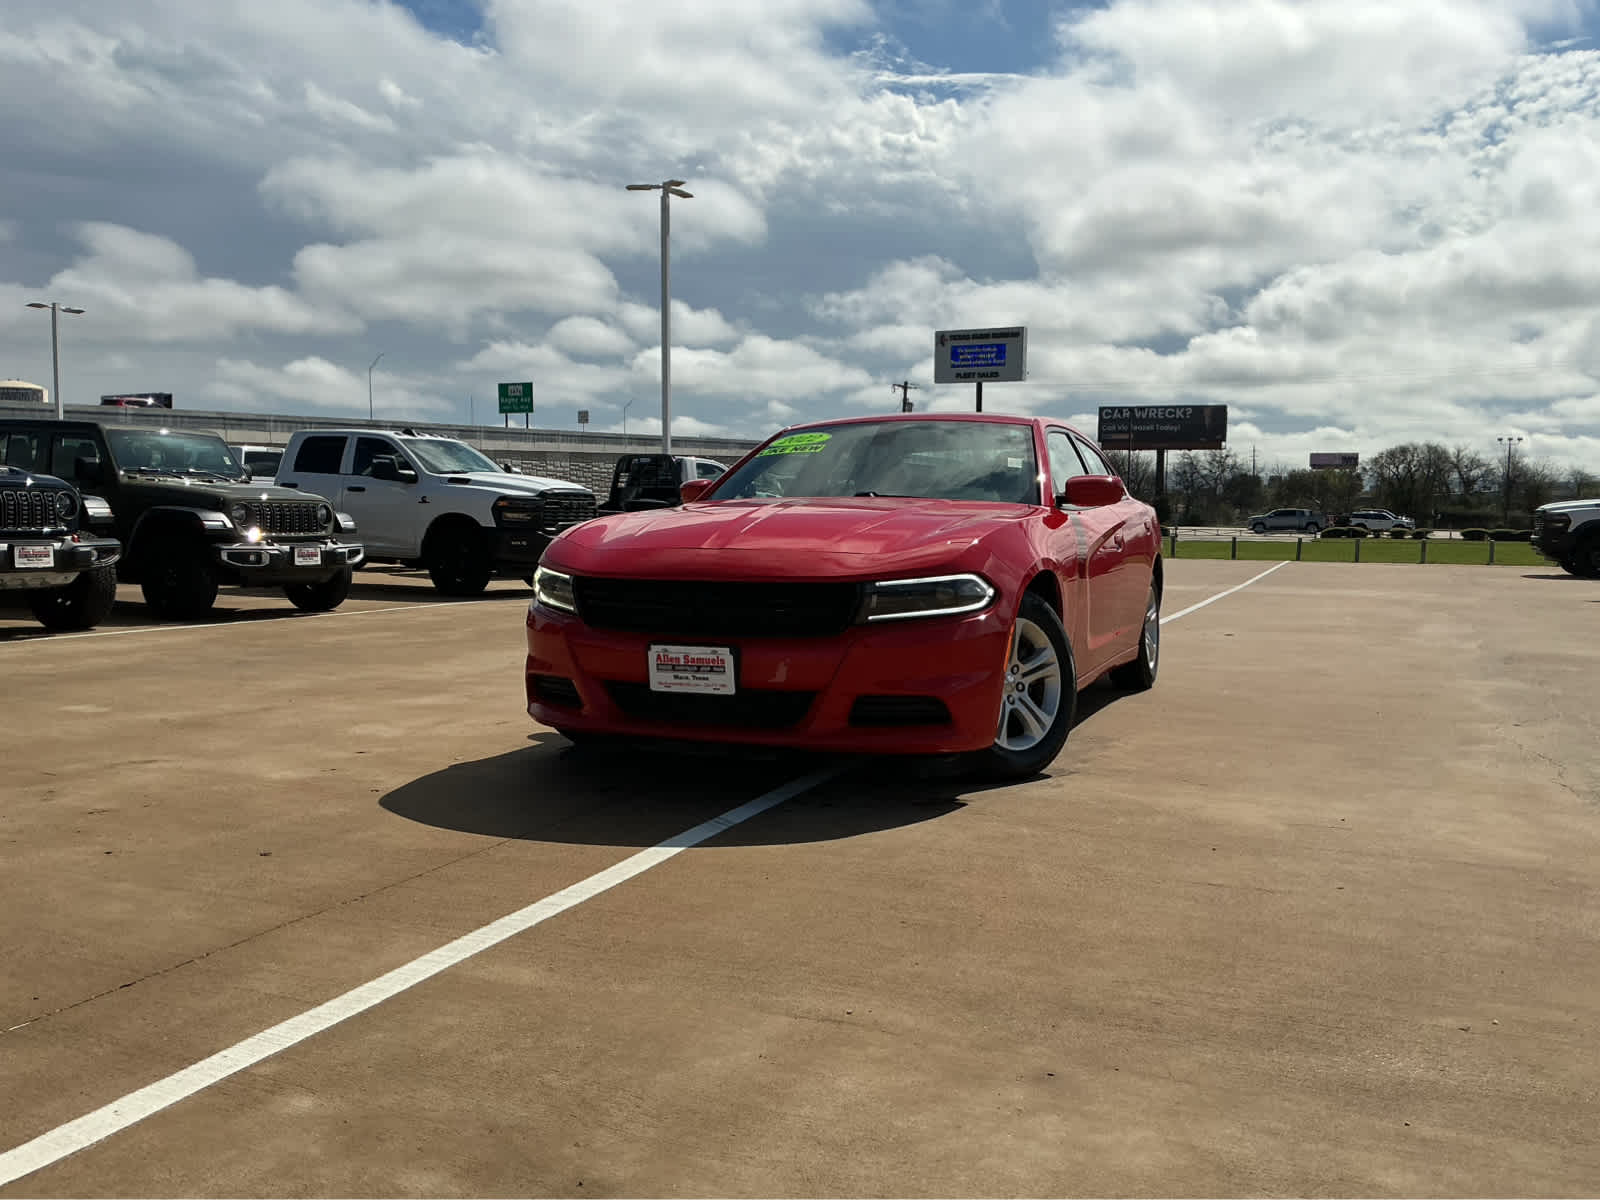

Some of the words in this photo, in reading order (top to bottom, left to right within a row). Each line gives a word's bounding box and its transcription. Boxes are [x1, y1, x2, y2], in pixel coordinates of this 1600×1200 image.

[1102, 408, 1130, 419] CAR
[1134, 407, 1193, 419] WRECK?
[656, 653, 681, 665] Allen
[683, 655, 726, 665] Samuels
